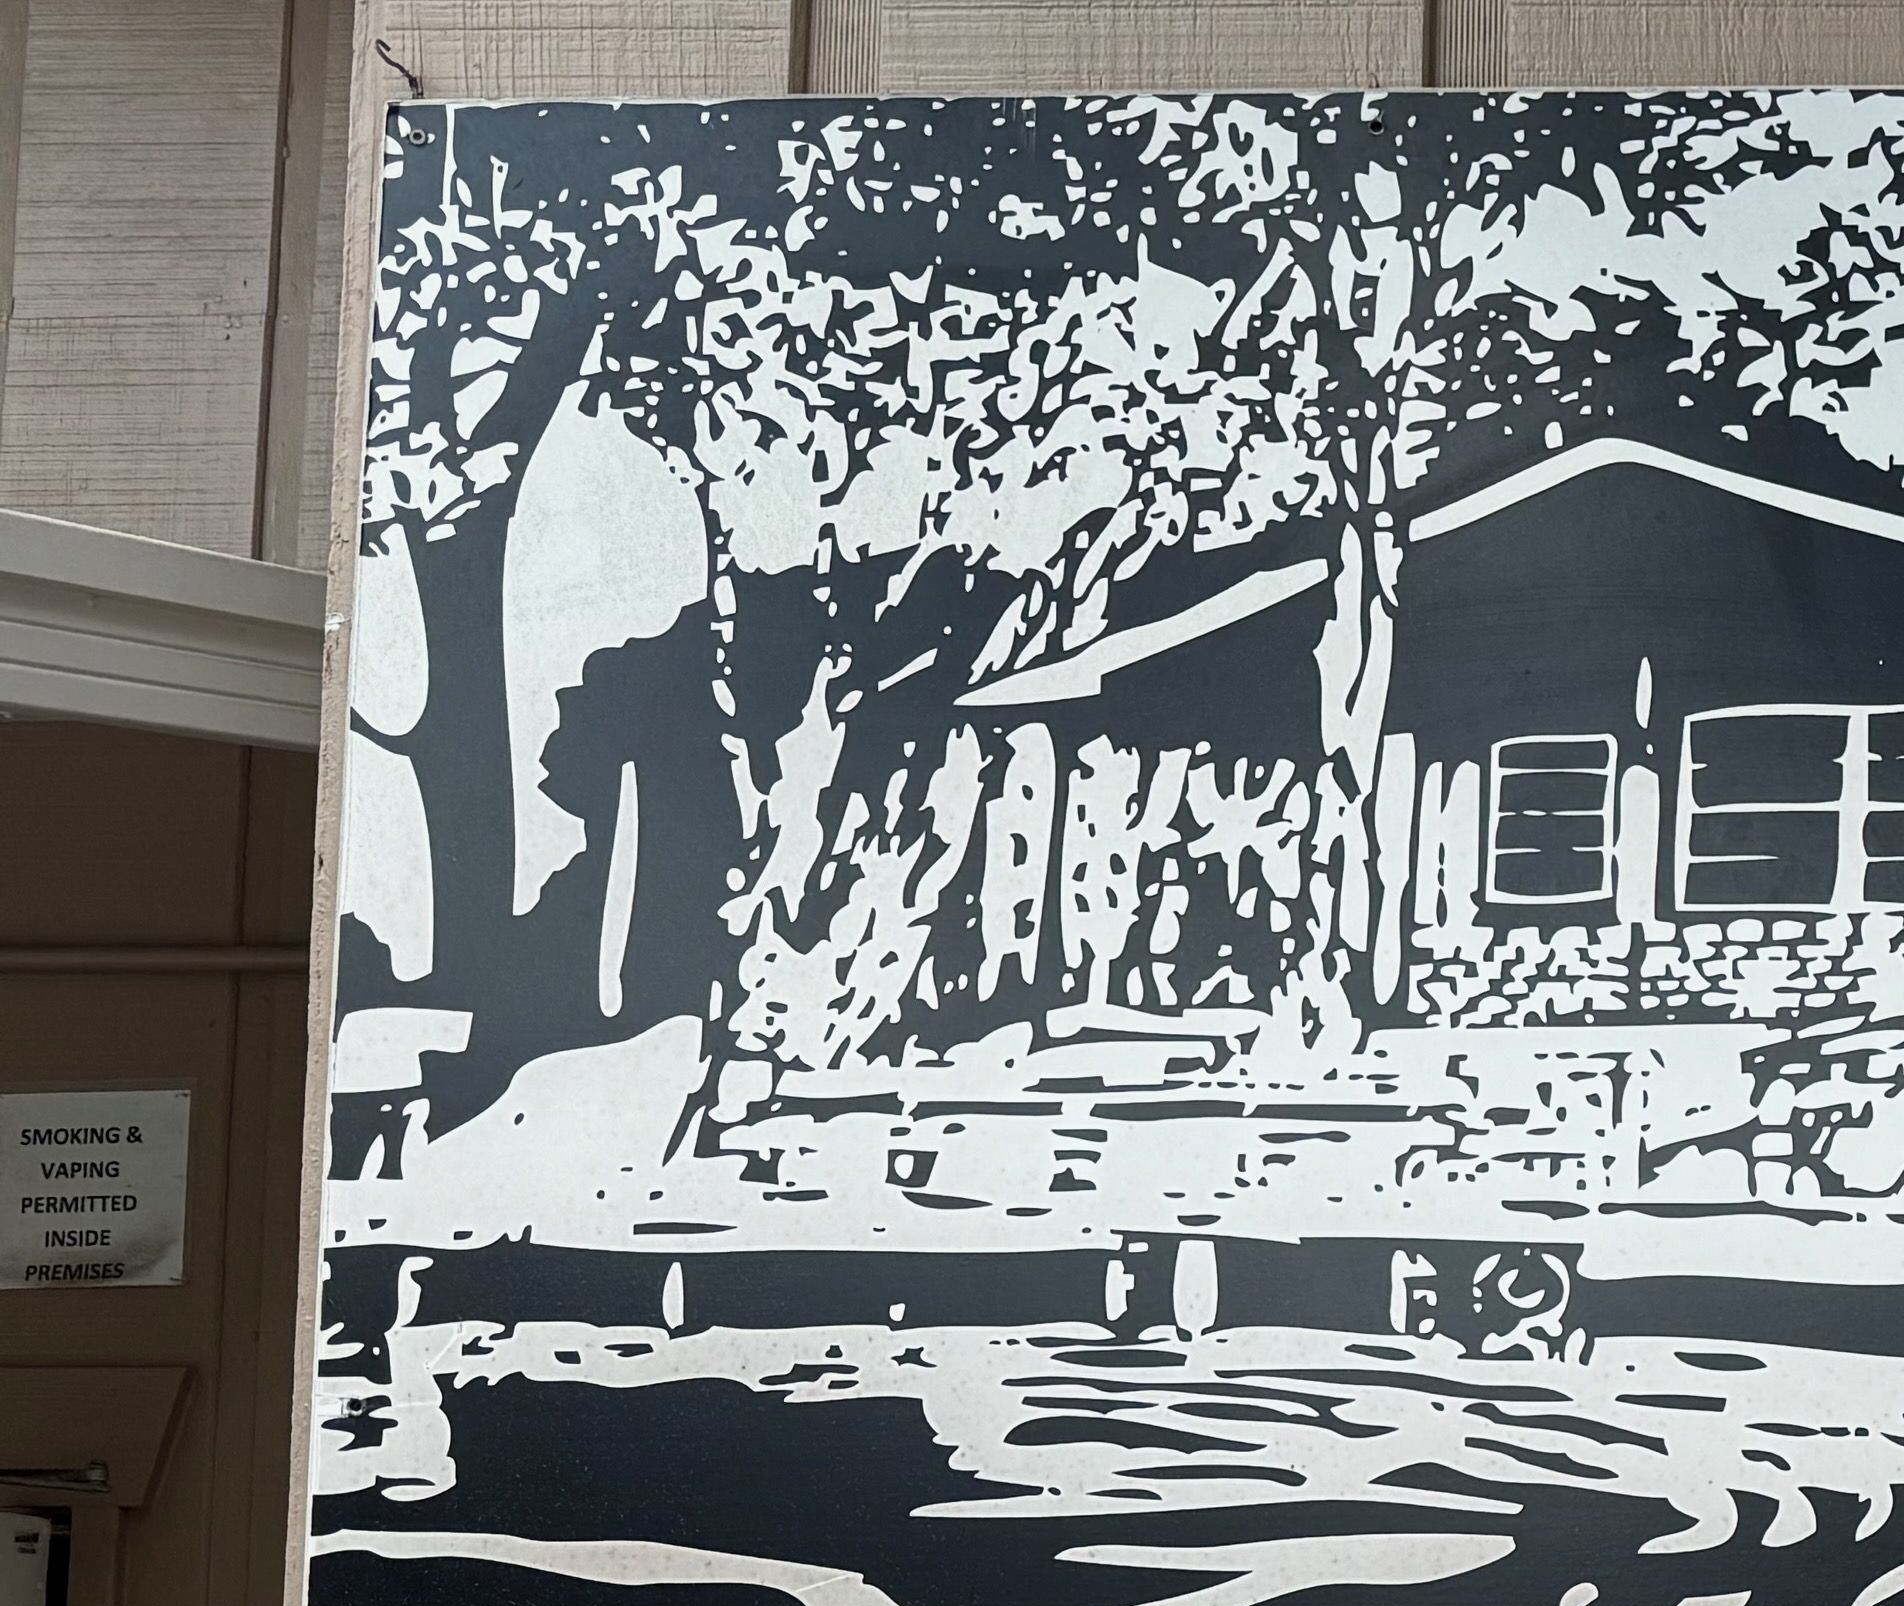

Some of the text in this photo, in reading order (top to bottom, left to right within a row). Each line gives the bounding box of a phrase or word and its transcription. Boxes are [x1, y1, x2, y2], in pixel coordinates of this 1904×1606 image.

[20, 1126, 143, 1145] SMOKING &
[41, 1161, 120, 1179] VAPING
[21, 1195, 137, 1213] PERMITTED
[45, 1230, 111, 1247] INSIDE
[25, 1263, 125, 1281] PREMISES
